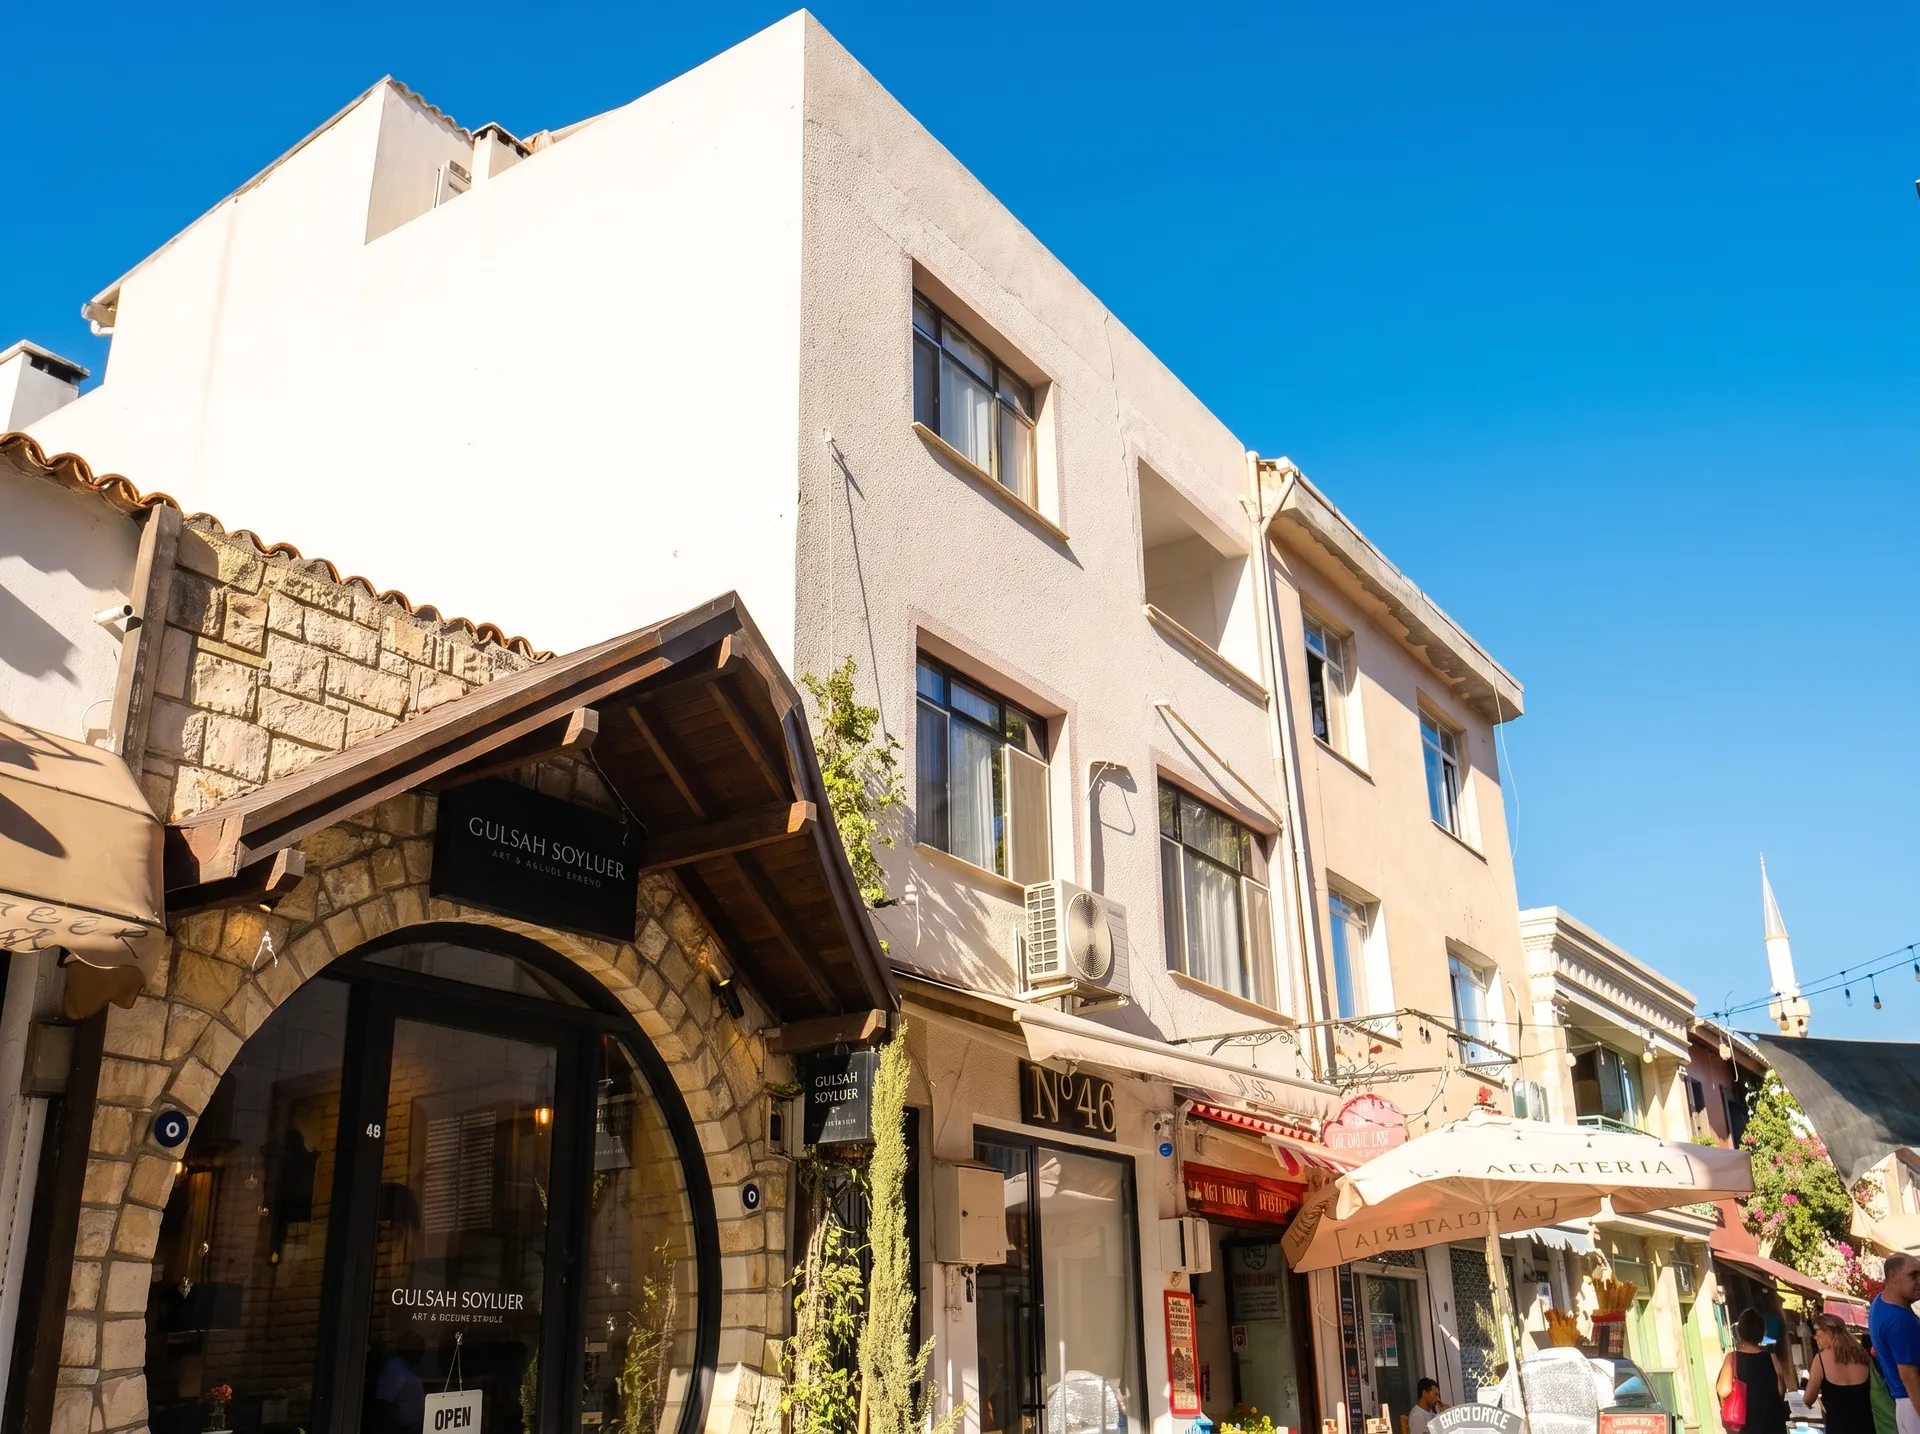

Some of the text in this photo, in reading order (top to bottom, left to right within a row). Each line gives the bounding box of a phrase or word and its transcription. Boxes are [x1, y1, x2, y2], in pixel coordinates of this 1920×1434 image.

[468, 817, 626, 881] GULSAH SOYLUER
[492, 850, 511, 861] ART
[815, 1071, 859, 1088] GULSAH
[814, 1087, 860, 1104] SOYLUER
[366, 1123, 381, 1138] 48
[391, 1288, 524, 1310] GULSAH SOYLUER
[411, 1312, 428, 1321] ART
[435, 1406, 471, 1431] OPEN
